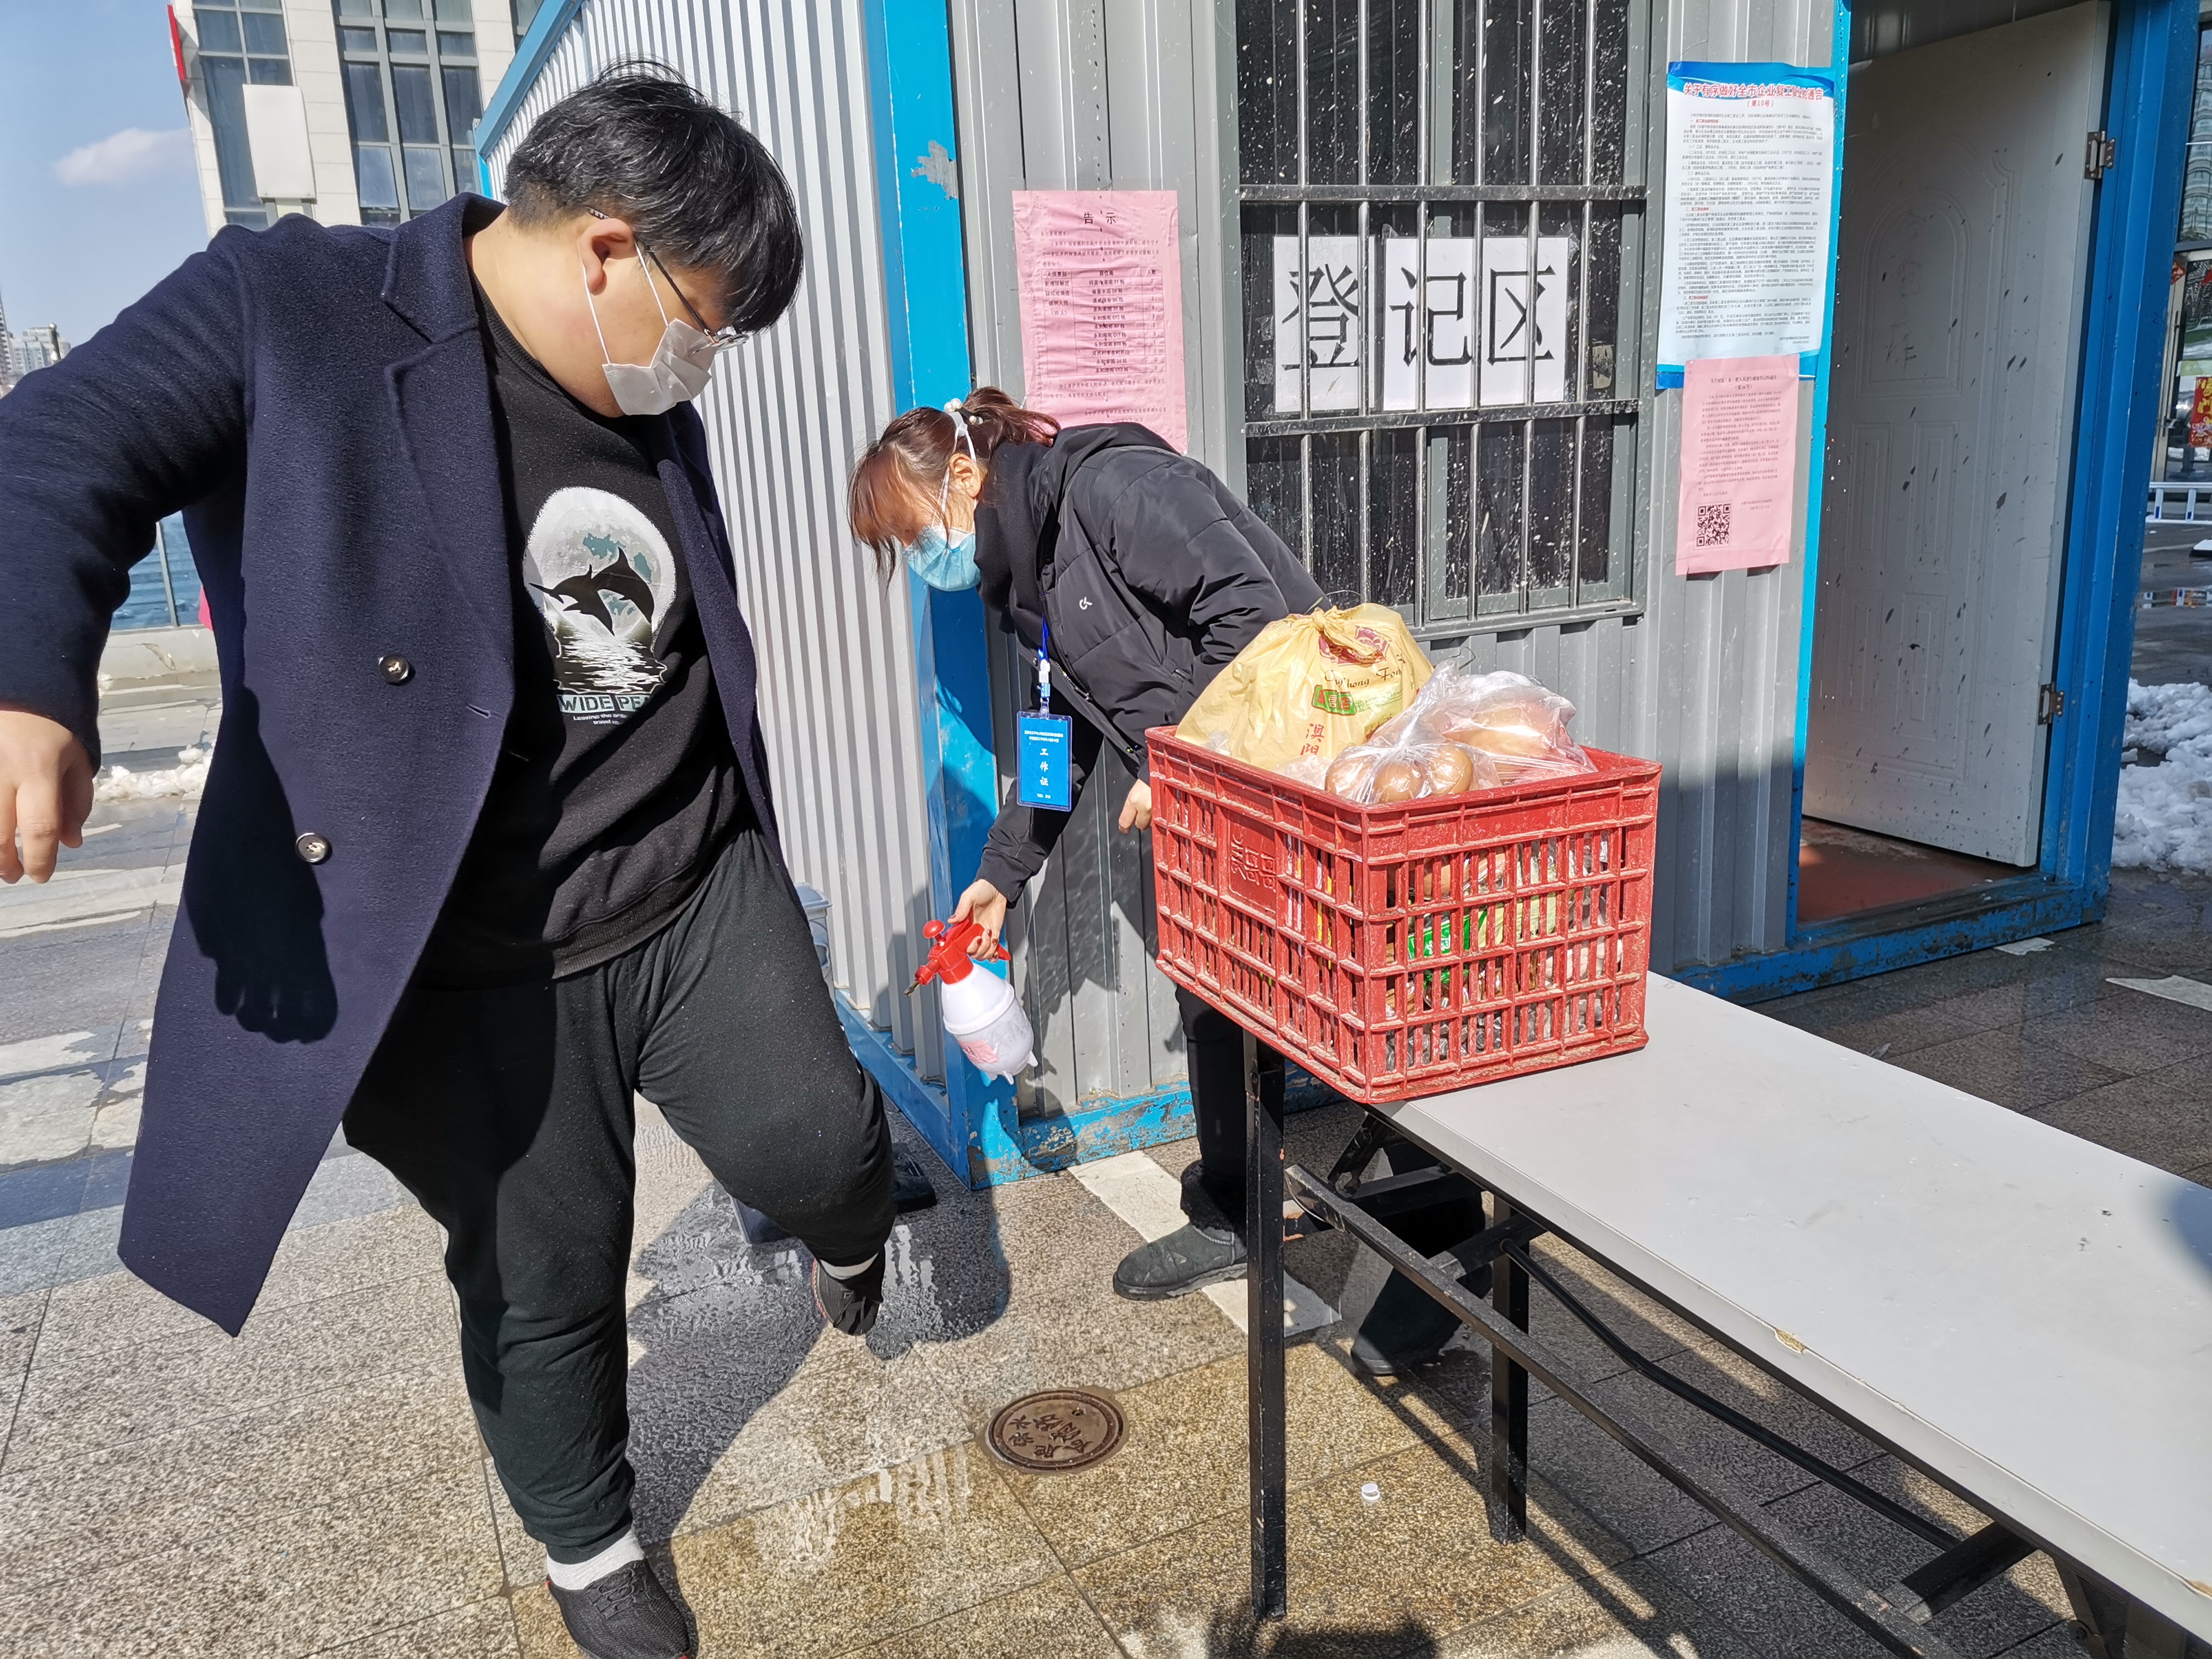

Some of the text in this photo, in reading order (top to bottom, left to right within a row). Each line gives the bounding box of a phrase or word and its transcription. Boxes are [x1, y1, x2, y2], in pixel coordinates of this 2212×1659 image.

[1083, 212, 1116, 225] 告示
[1281, 264, 1556, 371] 登记区
[557, 695, 613, 712] WIDE
[1040, 748, 1049, 786] 工作证
